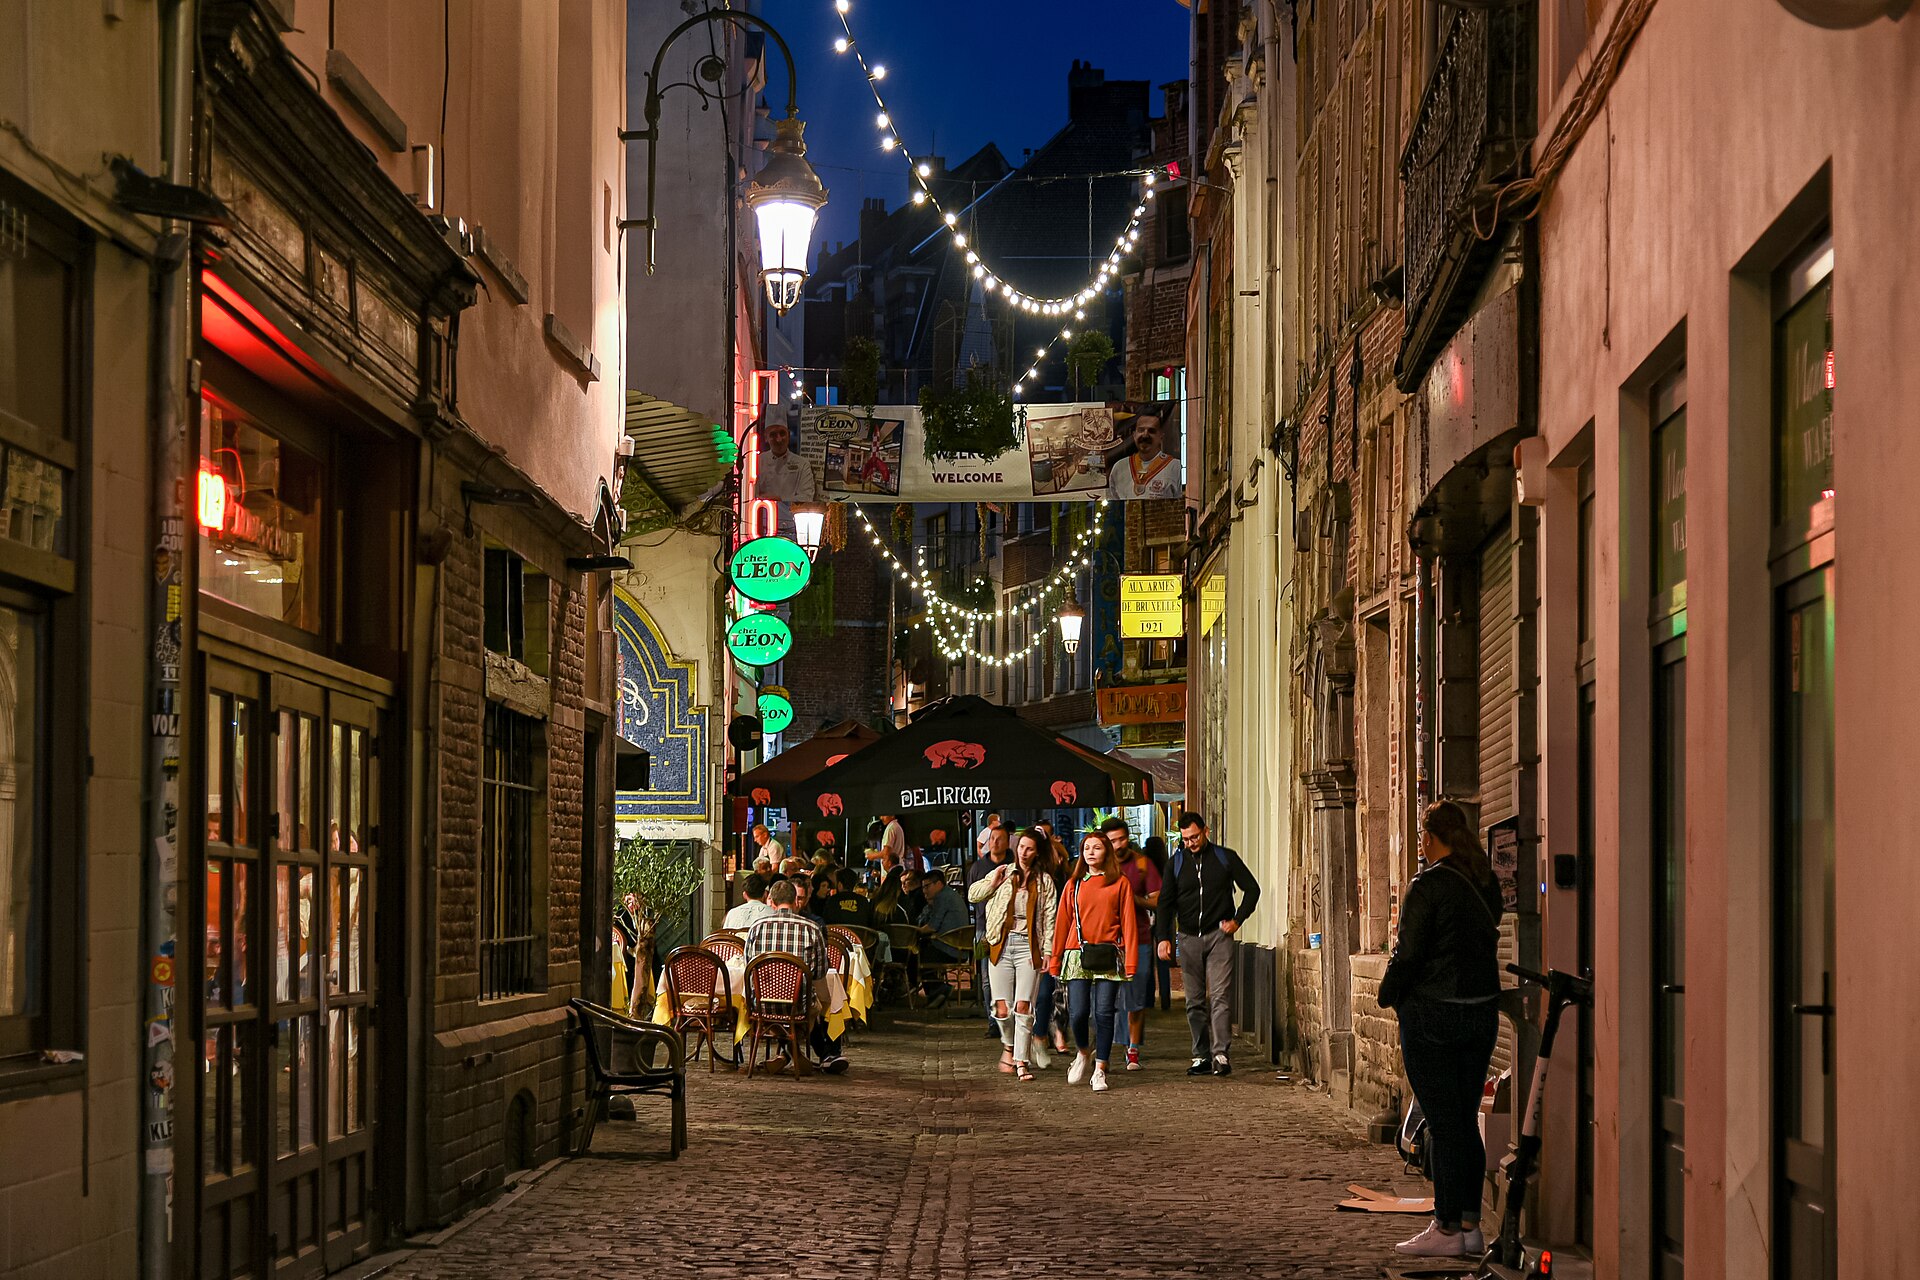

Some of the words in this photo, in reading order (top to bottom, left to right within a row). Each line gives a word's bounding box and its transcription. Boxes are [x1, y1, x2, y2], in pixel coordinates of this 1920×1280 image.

[819, 419, 855, 429] LEON
[931, 472, 1004, 483] WELCOME
[743, 554, 768, 563] chez
[735, 561, 805, 579] LEON
[1128, 581, 1144, 592] AUX
[1148, 580, 1175, 591] ARMES
[1122, 602, 1132, 611] DE
[1136, 601, 1181, 611] BRUXELLES
[1141, 622, 1162, 632] 1921
[731, 633, 787, 647] LEON
[761, 708, 789, 720] EON
[900, 786, 991, 808] DELIRIUM
